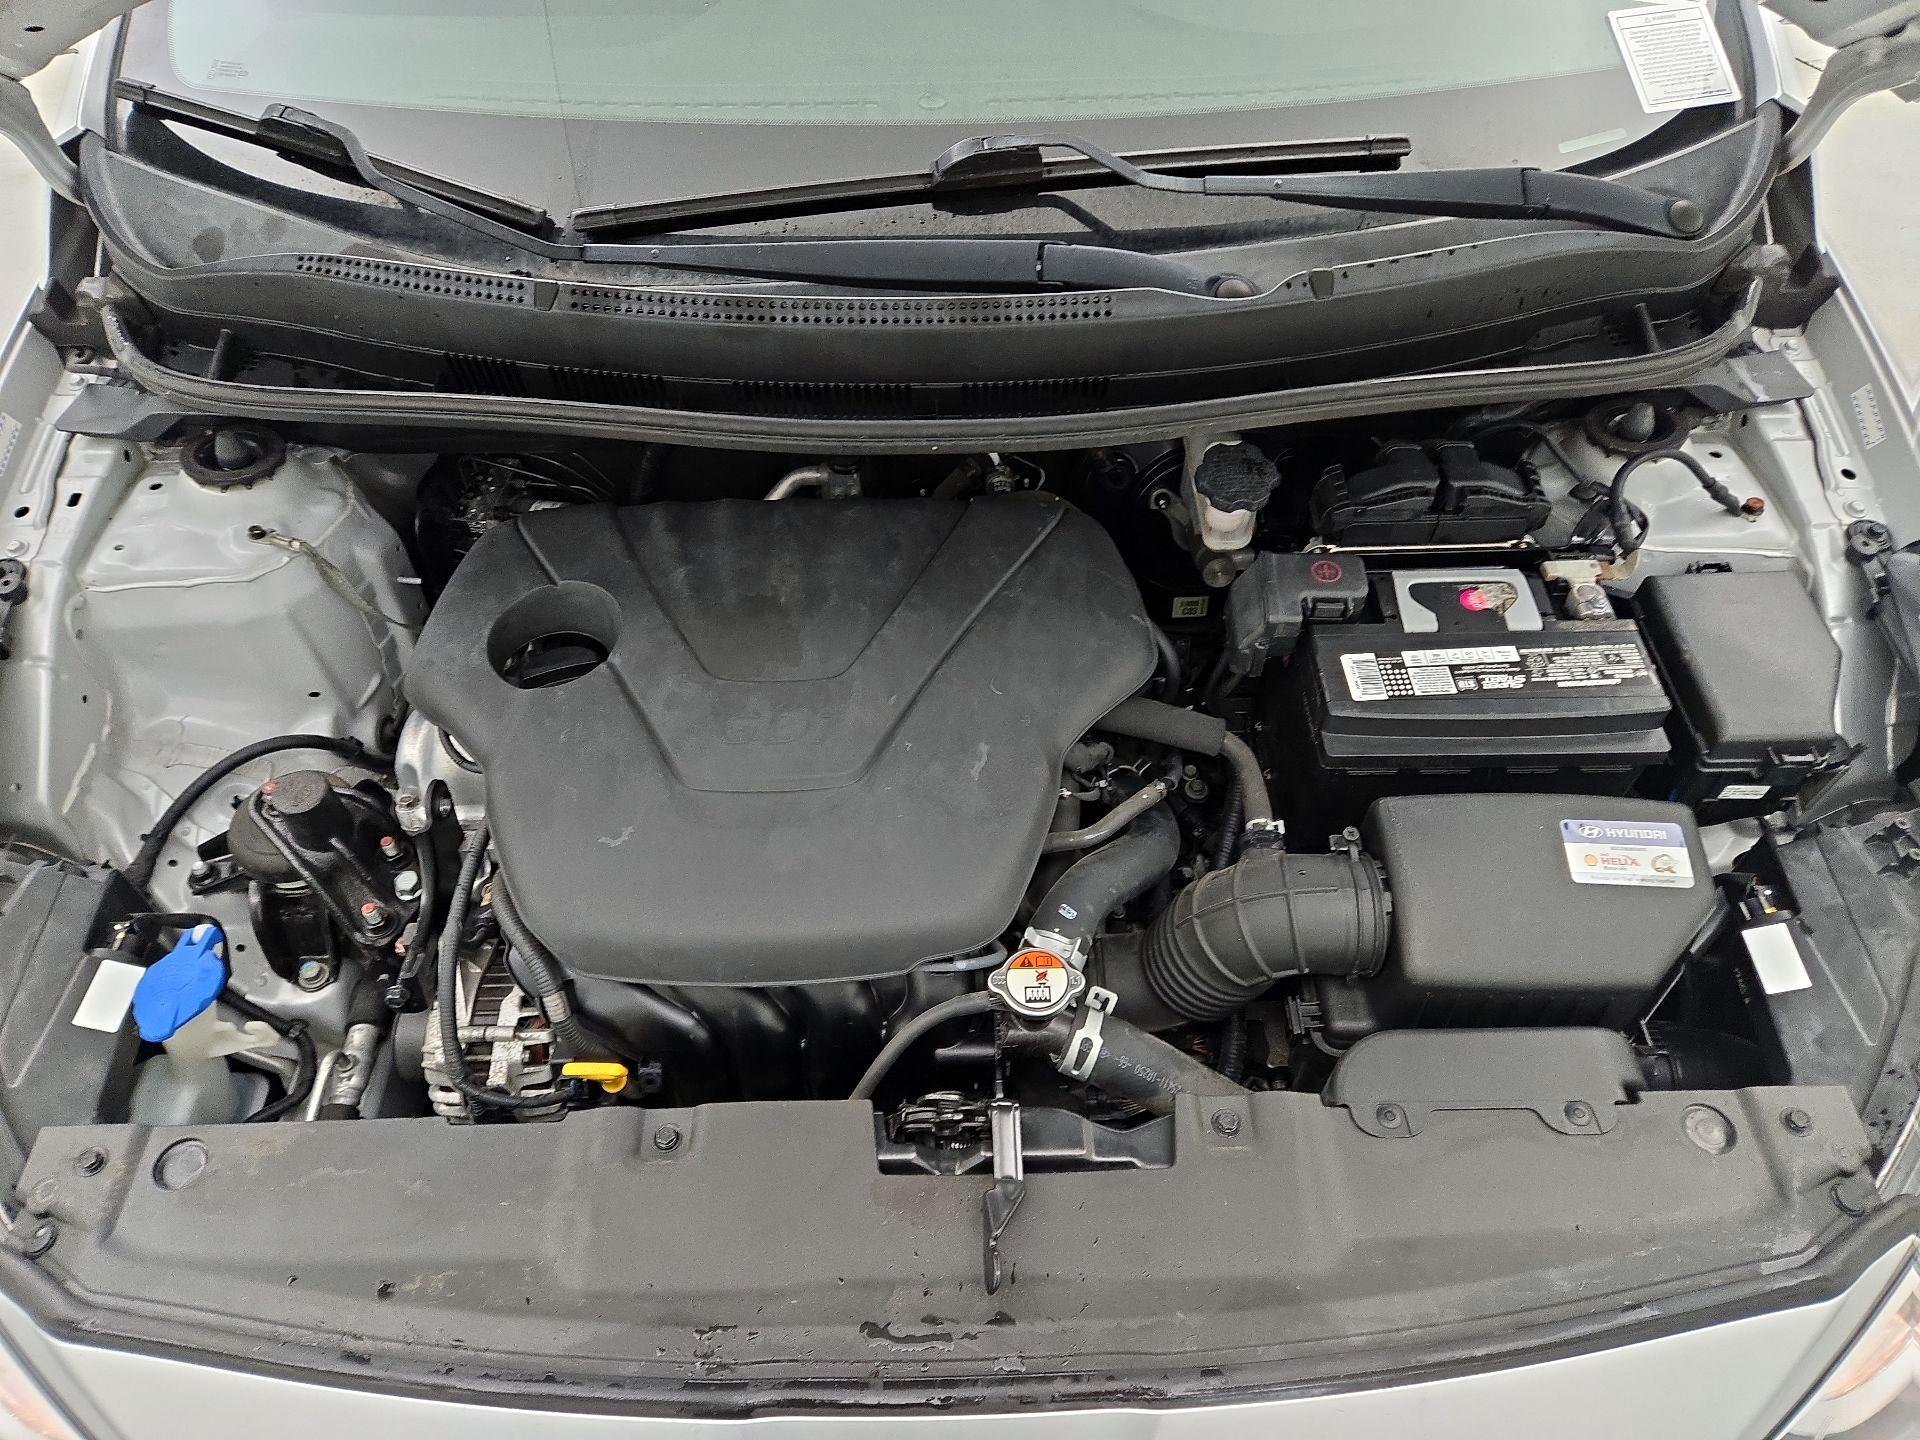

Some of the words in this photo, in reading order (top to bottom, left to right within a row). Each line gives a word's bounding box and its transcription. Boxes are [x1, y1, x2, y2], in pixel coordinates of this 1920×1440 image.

[1478, 674, 1527, 684] START
[1483, 682, 1524, 690] SUPER
[1605, 827, 1668, 840] HYUNDAI
